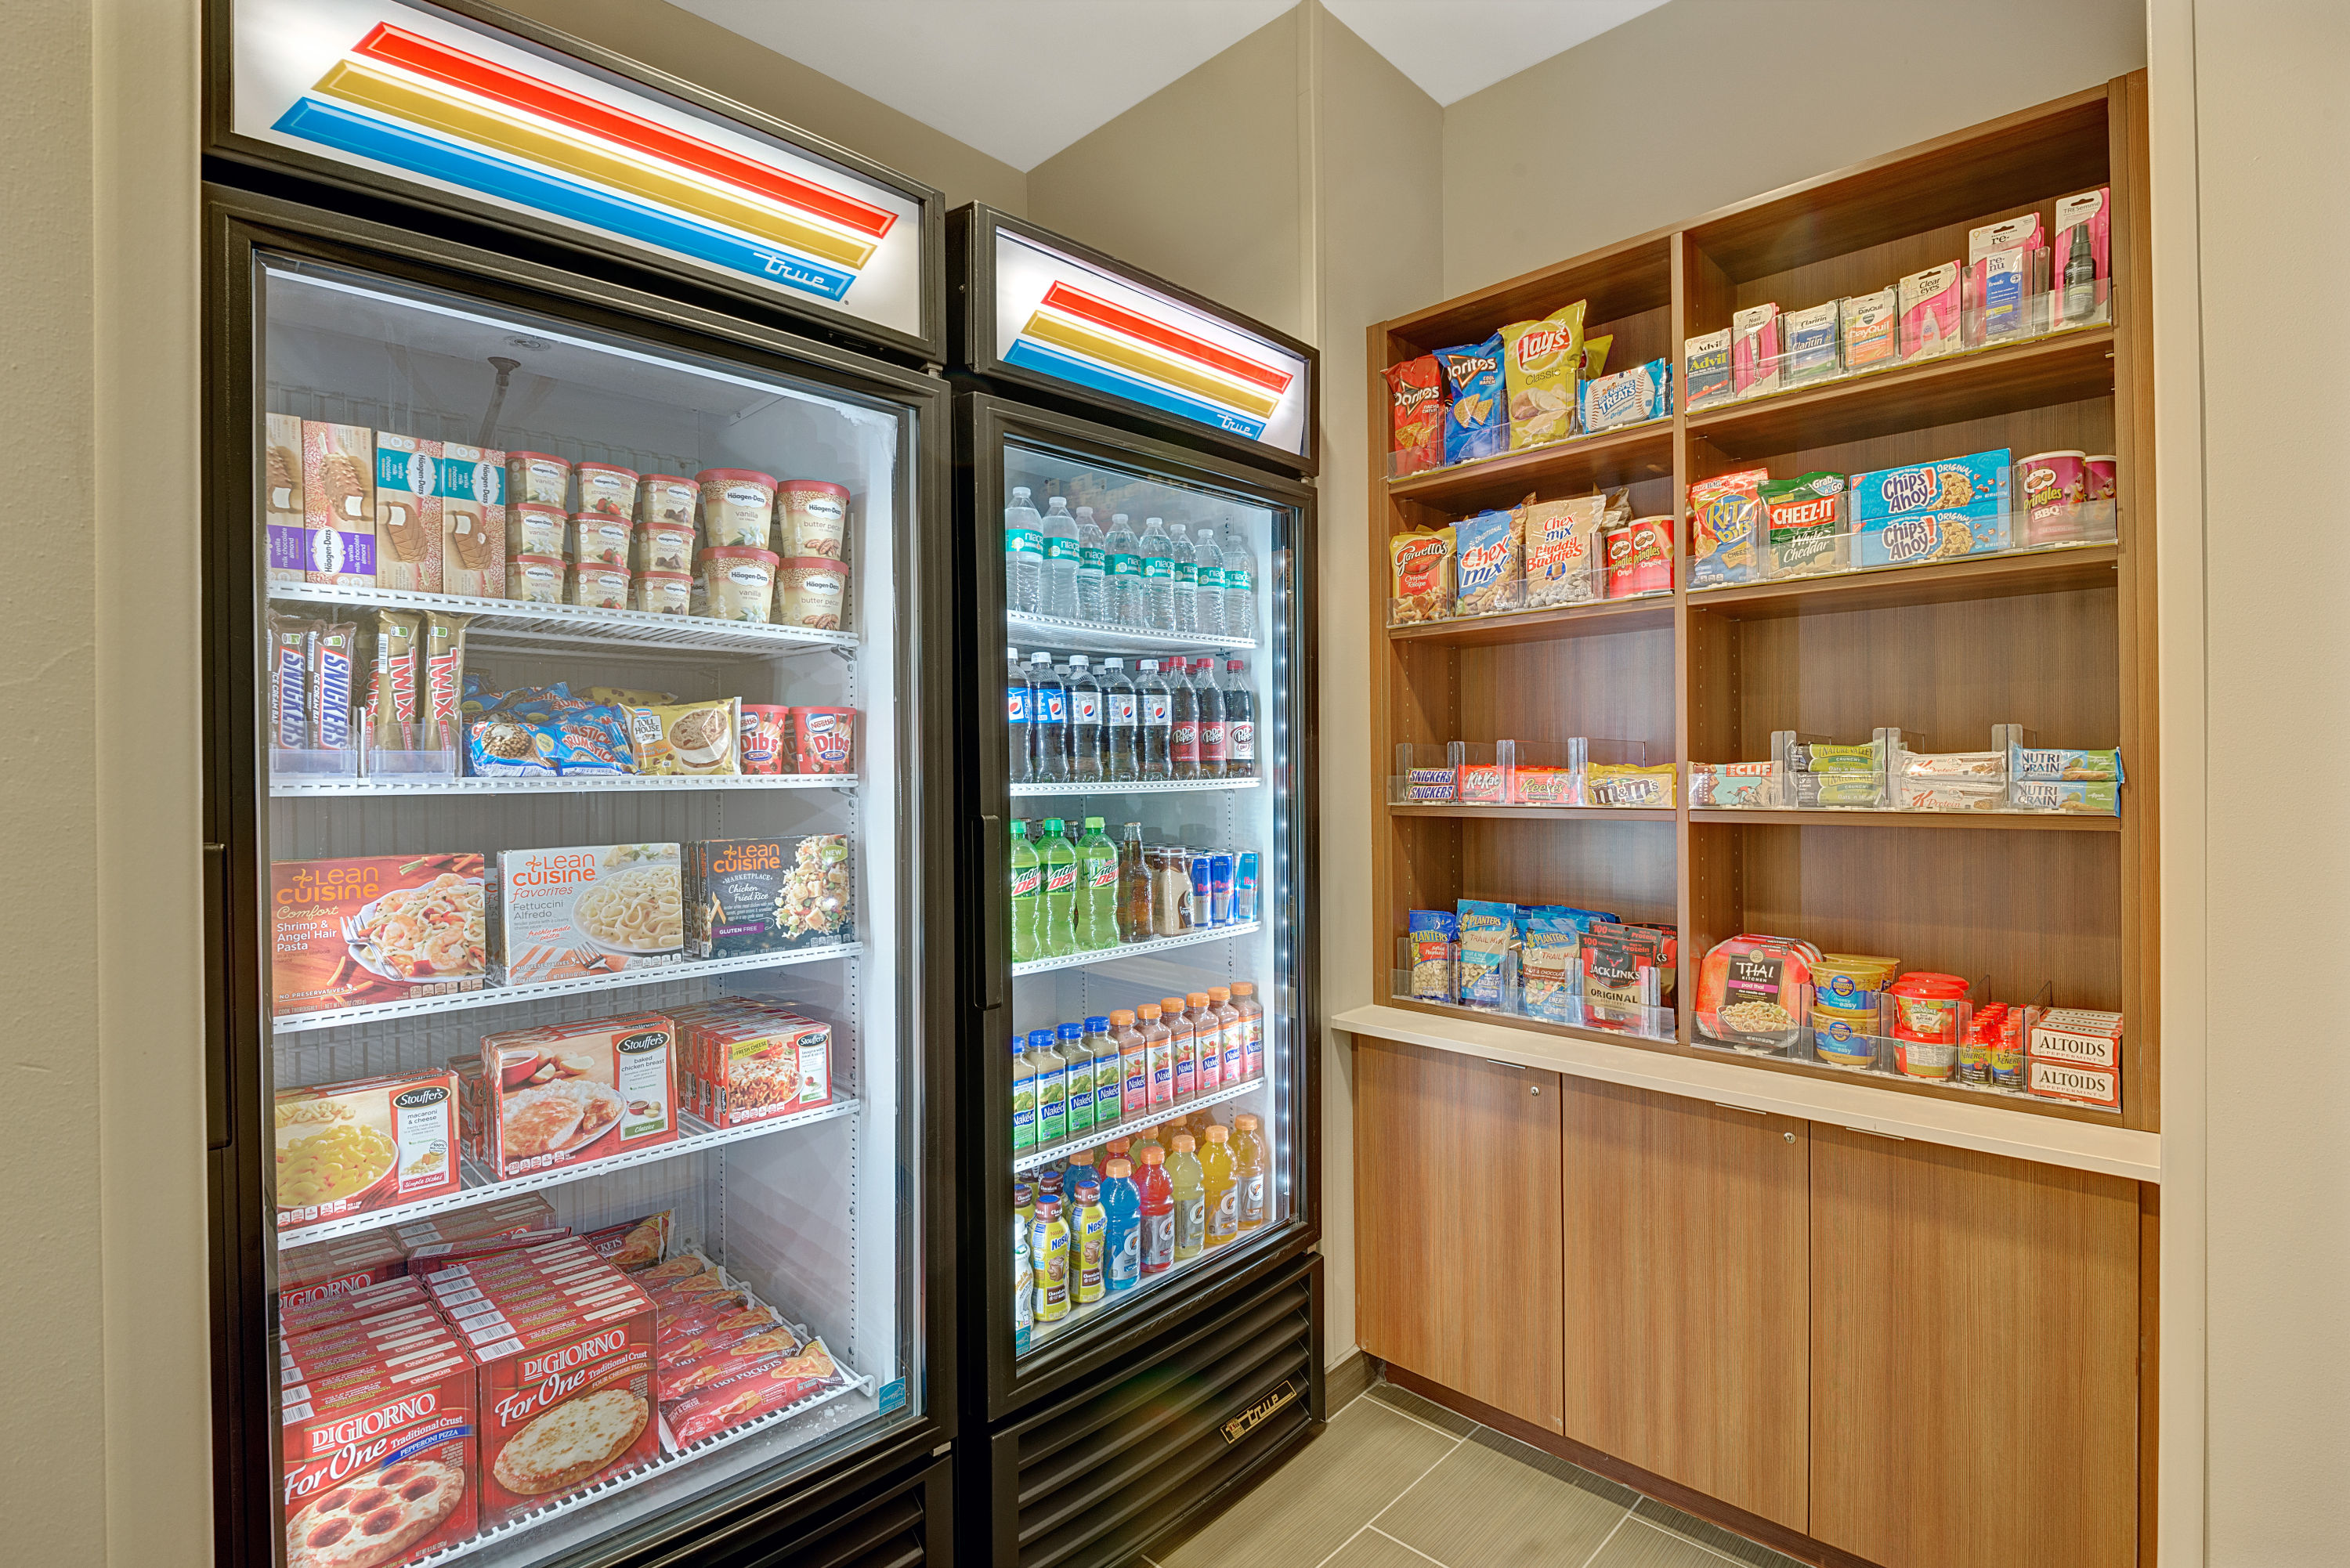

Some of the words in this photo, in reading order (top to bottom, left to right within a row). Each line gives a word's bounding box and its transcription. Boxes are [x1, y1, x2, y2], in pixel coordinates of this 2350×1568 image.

[2063, 200, 2101, 214] TRESemmé
[754, 252, 829, 291] true
[1919, 277, 1941, 289] Clear
[1858, 303, 1883, 314] DayQuil
[1801, 315, 1827, 327] Claritin
[1848, 321, 1889, 338] DayQuil
[1522, 328, 1567, 363] Lay's
[1697, 341, 1723, 352] Advil
[1792, 334, 1823, 352] Claritin
[1690, 352, 1726, 372] Advil
[1525, 368, 1561, 386] Classic
[1395, 385, 1439, 406] Doritos
[1599, 387, 1636, 414] TREATS
[1610, 402, 1634, 420] Original
[1217, 414, 1253, 436] true
[1937, 463, 1972, 476] ORIGINAL
[1813, 475, 1833, 490] Grab
[1882, 471, 1926, 496] Chips
[591, 490, 622, 499] strawberry
[2023, 486, 2063, 511] Pringles
[1708, 499, 1753, 532] RITZ
[1773, 499, 1834, 526] CHEEZ-IT
[2034, 506, 2060, 519] BBQ
[1544, 511, 1578, 532] Chex
[1882, 519, 1926, 544] Chips
[1461, 534, 1512, 569] Chex
[1633, 545, 1661, 569] Pringles
[1783, 539, 1830, 563] Cheddar
[1527, 544, 1583, 573] Buddies
[389, 648, 416, 721] TWIX
[429, 648, 457, 720] TWIX
[281, 652, 305, 749] SNICKERS
[323, 654, 349, 749] SNICKERS
[634, 725, 660, 734] HOUSE
[810, 719, 833, 728] Nestlé
[815, 733, 849, 752] Dibs
[1175, 731, 1195, 743] Pepper
[562, 735, 616, 763] DRUMSTICK
[1822, 746, 1849, 756] NATURE
[1850, 748, 1873, 757] VALLEY
[2023, 753, 2060, 764] NUTRI
[1736, 764, 1770, 776] CLIF
[2023, 762, 2059, 772] GRAIN
[1410, 771, 1453, 783] SNICKERS
[1520, 779, 1564, 795] Reese's
[2019, 784, 2058, 796] NUTRI
[2018, 795, 2058, 806] GRAIN
[544, 854, 595, 870] Lean
[315, 867, 378, 885] Lean
[724, 873, 771, 883] MARKETPLACE
[728, 883, 758, 894] Chicken
[734, 893, 754, 902] Fried
[277, 905, 338, 919] Comfort
[513, 900, 563, 911] Fettuccini
[514, 910, 552, 920] Alfredo
[1470, 916, 1501, 927] PLANTERS
[277, 922, 317, 932] Shrimp
[320, 919, 328, 928] &
[1593, 924, 1607, 934] 100
[277, 931, 310, 943] Angel
[314, 929, 337, 939] Hair
[527, 927, 552, 939] freshly
[540, 933, 559, 941] pasta
[1410, 931, 1448, 942] PLANTERS
[1470, 934, 1488, 944] TRAIL
[1535, 933, 1569, 945] PLANTERS
[1631, 932, 1657, 941] Protein
[277, 942, 308, 952] Pasta
[1583, 938, 1598, 946] 100
[1589, 964, 1610, 977] JACK
[1736, 962, 1773, 978] THAI
[292, 987, 345, 998] PRESERVATIVES
[1590, 988, 1638, 1004] ORIGINAL
[1839, 1001, 1856, 1010] easy
[1911, 1006, 1938, 1015] BOYARDEE
[623, 1034, 663, 1051] Stouffer's
[736, 1046, 750, 1057] FRESH
[750, 1041, 767, 1050] CHEESE
[2039, 1036, 2106, 1057] ALTOIDS
[2046, 1050, 2099, 1063] PEPPERMINT
[621, 1064, 645, 1072] chicken
[645, 1058, 664, 1068] breast
[2039, 1070, 2106, 1092] ALTOIDS
[400, 1089, 443, 1106] Stouffer's
[2046, 1084, 2098, 1097] PEPPERMINT
[407, 1110, 438, 1118] macaroni
[1044, 1102, 1065, 1117] Naked
[634, 1124, 655, 1134] Classics
[404, 1178, 423, 1188] Simple
[425, 1174, 443, 1183] Dishes
[588, 1354, 627, 1379] Traditional
[629, 1350, 647, 1361] Crust
[592, 1376, 607, 1389] FOUR
[609, 1367, 631, 1381] CHEESE
[631, 1362, 647, 1372] PIZZA
[711, 1375, 737, 1389] HOT
[737, 1359, 783, 1382] POCKETS
[495, 1391, 537, 1427] For
[538, 1369, 585, 1407] One
[391, 1422, 439, 1449] Traditional
[439, 1415, 463, 1429] Crust
[400, 1434, 437, 1457] PEPPERONI
[438, 1429, 458, 1441] PIZZA
[284, 1464, 327, 1505] For
[330, 1438, 387, 1480] One
